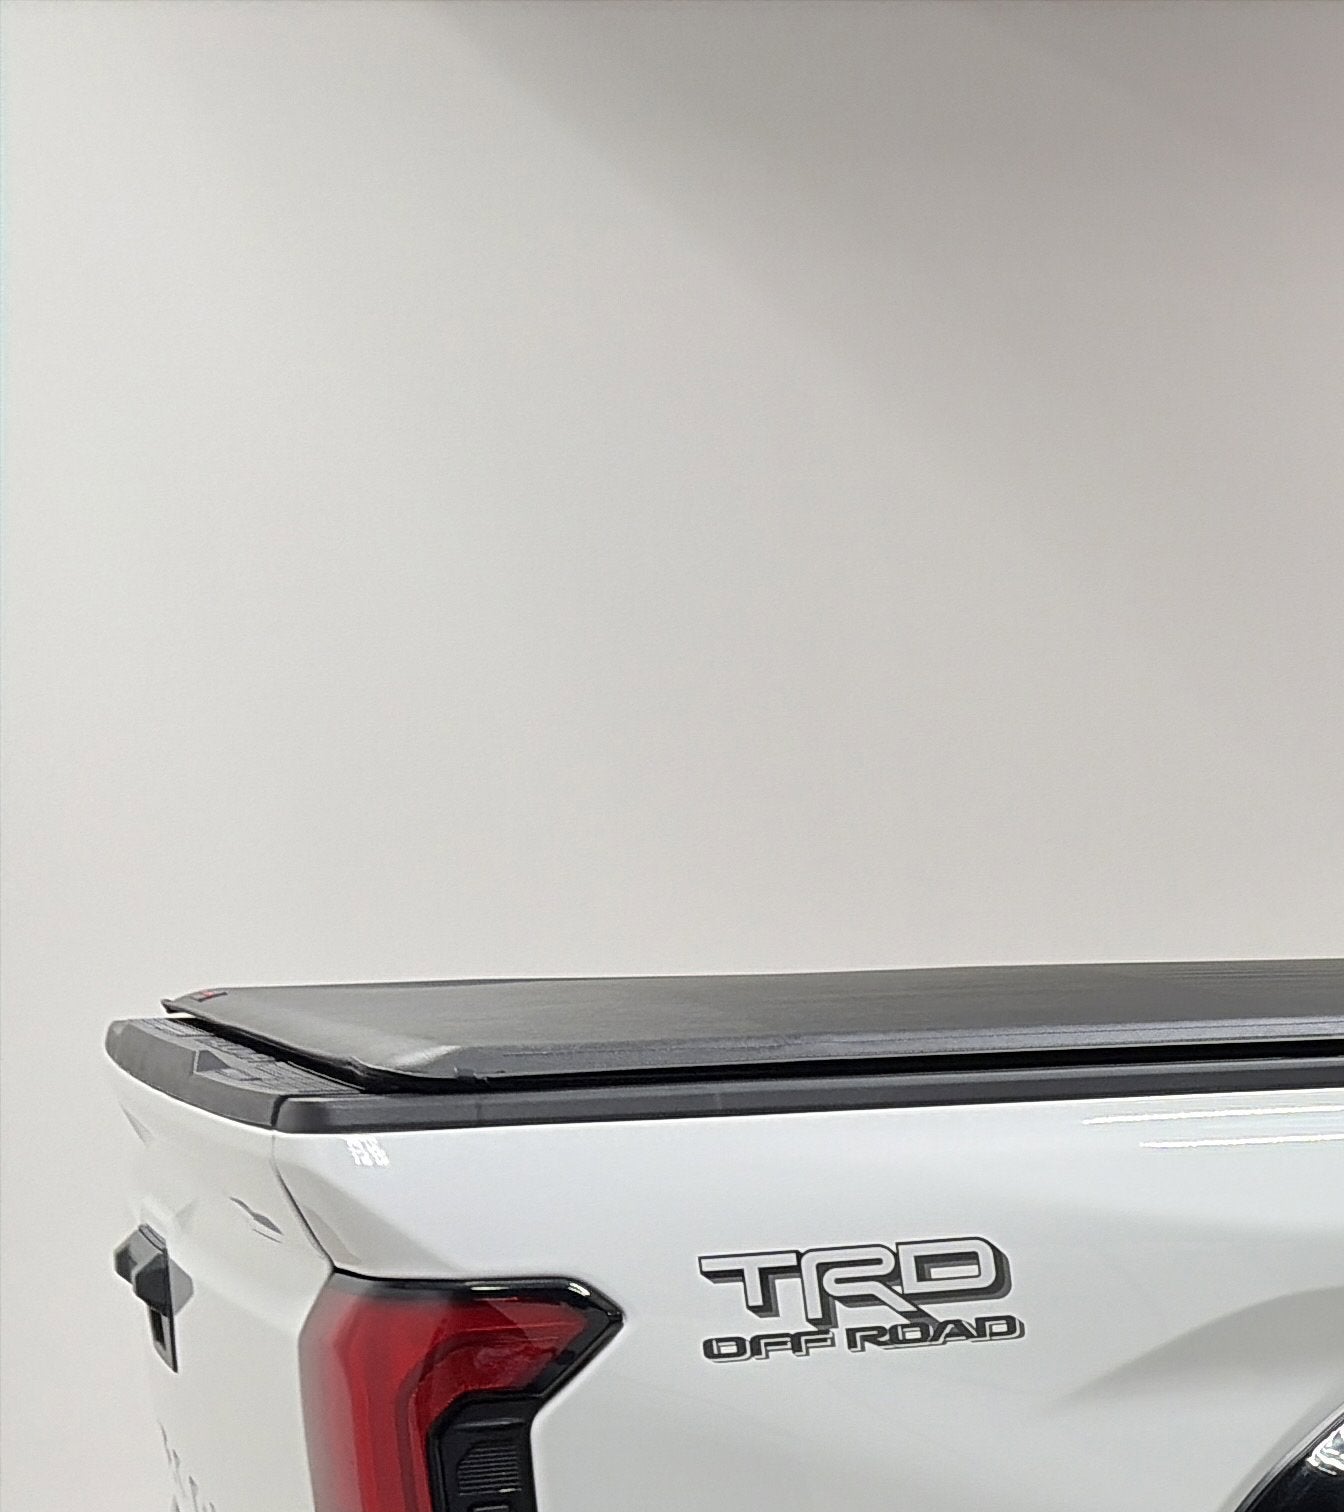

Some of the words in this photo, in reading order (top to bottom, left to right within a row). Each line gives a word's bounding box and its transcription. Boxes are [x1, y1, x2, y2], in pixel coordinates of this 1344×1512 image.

[698, 1236, 1013, 1330] TRD
[703, 1328, 836, 1364] OFF
[846, 1314, 1026, 1353] ROAD
